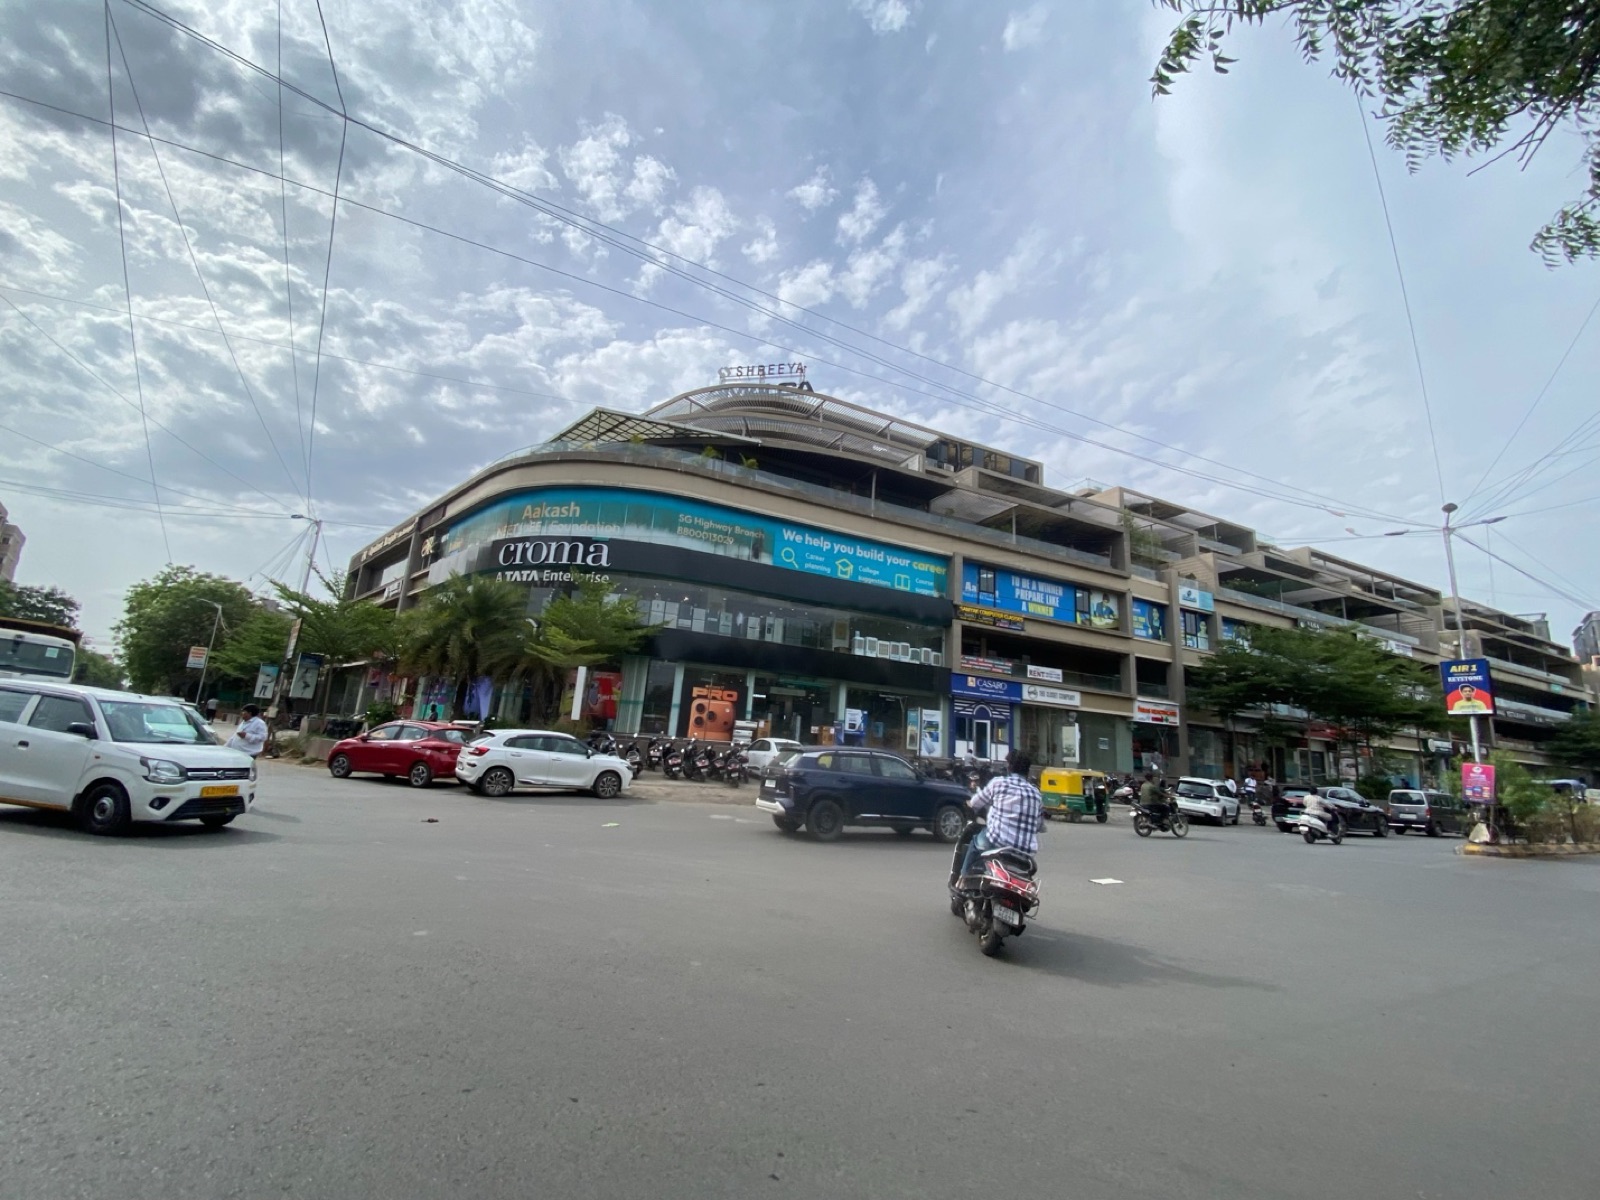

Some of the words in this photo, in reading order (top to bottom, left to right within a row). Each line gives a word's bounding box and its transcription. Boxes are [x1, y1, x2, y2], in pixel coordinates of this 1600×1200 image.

[736, 363, 804, 377] SHREEYA
[522, 501, 580, 519] Aakash
[550, 520, 620, 533] Foundation
[678, 514, 692, 523] SG
[694, 517, 733, 534] Highway
[735, 526, 764, 538] Branch
[498, 541, 612, 567] croma
[782, 528, 803, 543] We
[805, 533, 831, 552] help
[833, 543, 854, 555] you
[856, 545, 884, 561] build
[886, 555, 911, 567] your
[912, 561, 946, 575] career
[495, 572, 503, 582] A
[505, 570, 539, 582] TATA
[1450, 665, 1469, 673] AIR
[1471, 664, 1477, 672] 1
[692, 686, 738, 701] PRO
